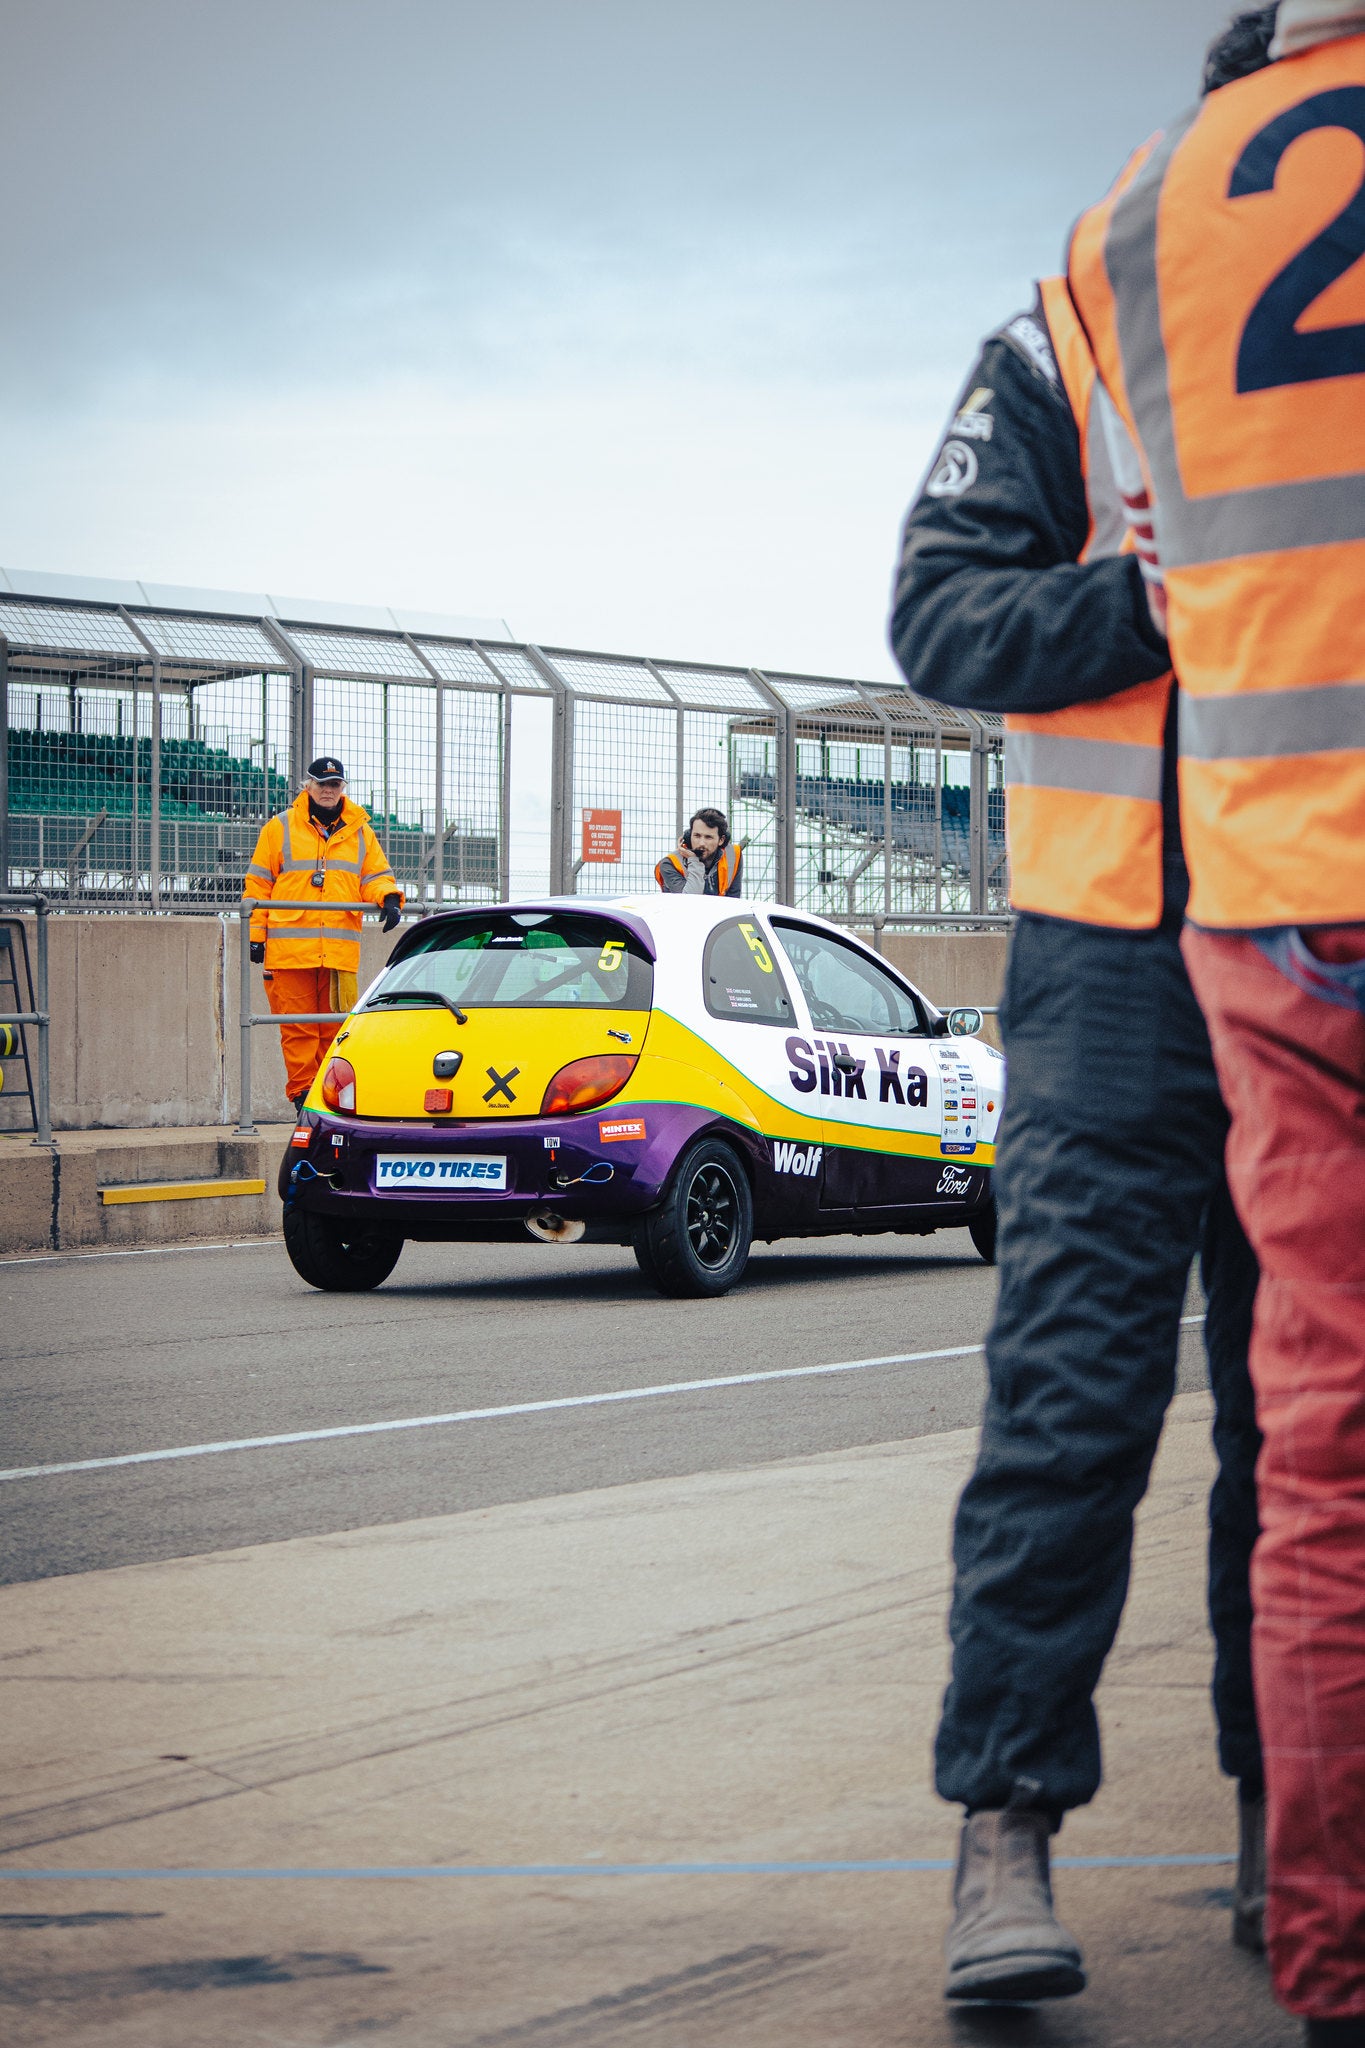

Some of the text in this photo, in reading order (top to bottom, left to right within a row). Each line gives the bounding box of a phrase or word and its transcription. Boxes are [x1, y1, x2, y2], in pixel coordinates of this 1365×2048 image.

[1227, 86, 1365, 394] 2
[598, 940, 625, 972] 5
[738, 923, 773, 973] 5
[785, 1036, 928, 1108] Silk Ka
[546, 1138, 558, 1147] TOW
[602, 1124, 642, 1134] MINTEX
[380, 1162, 503, 1179] TOYO TIRES
[774, 1142, 822, 1177] Wolf
[936, 1165, 971, 1194] Ford
